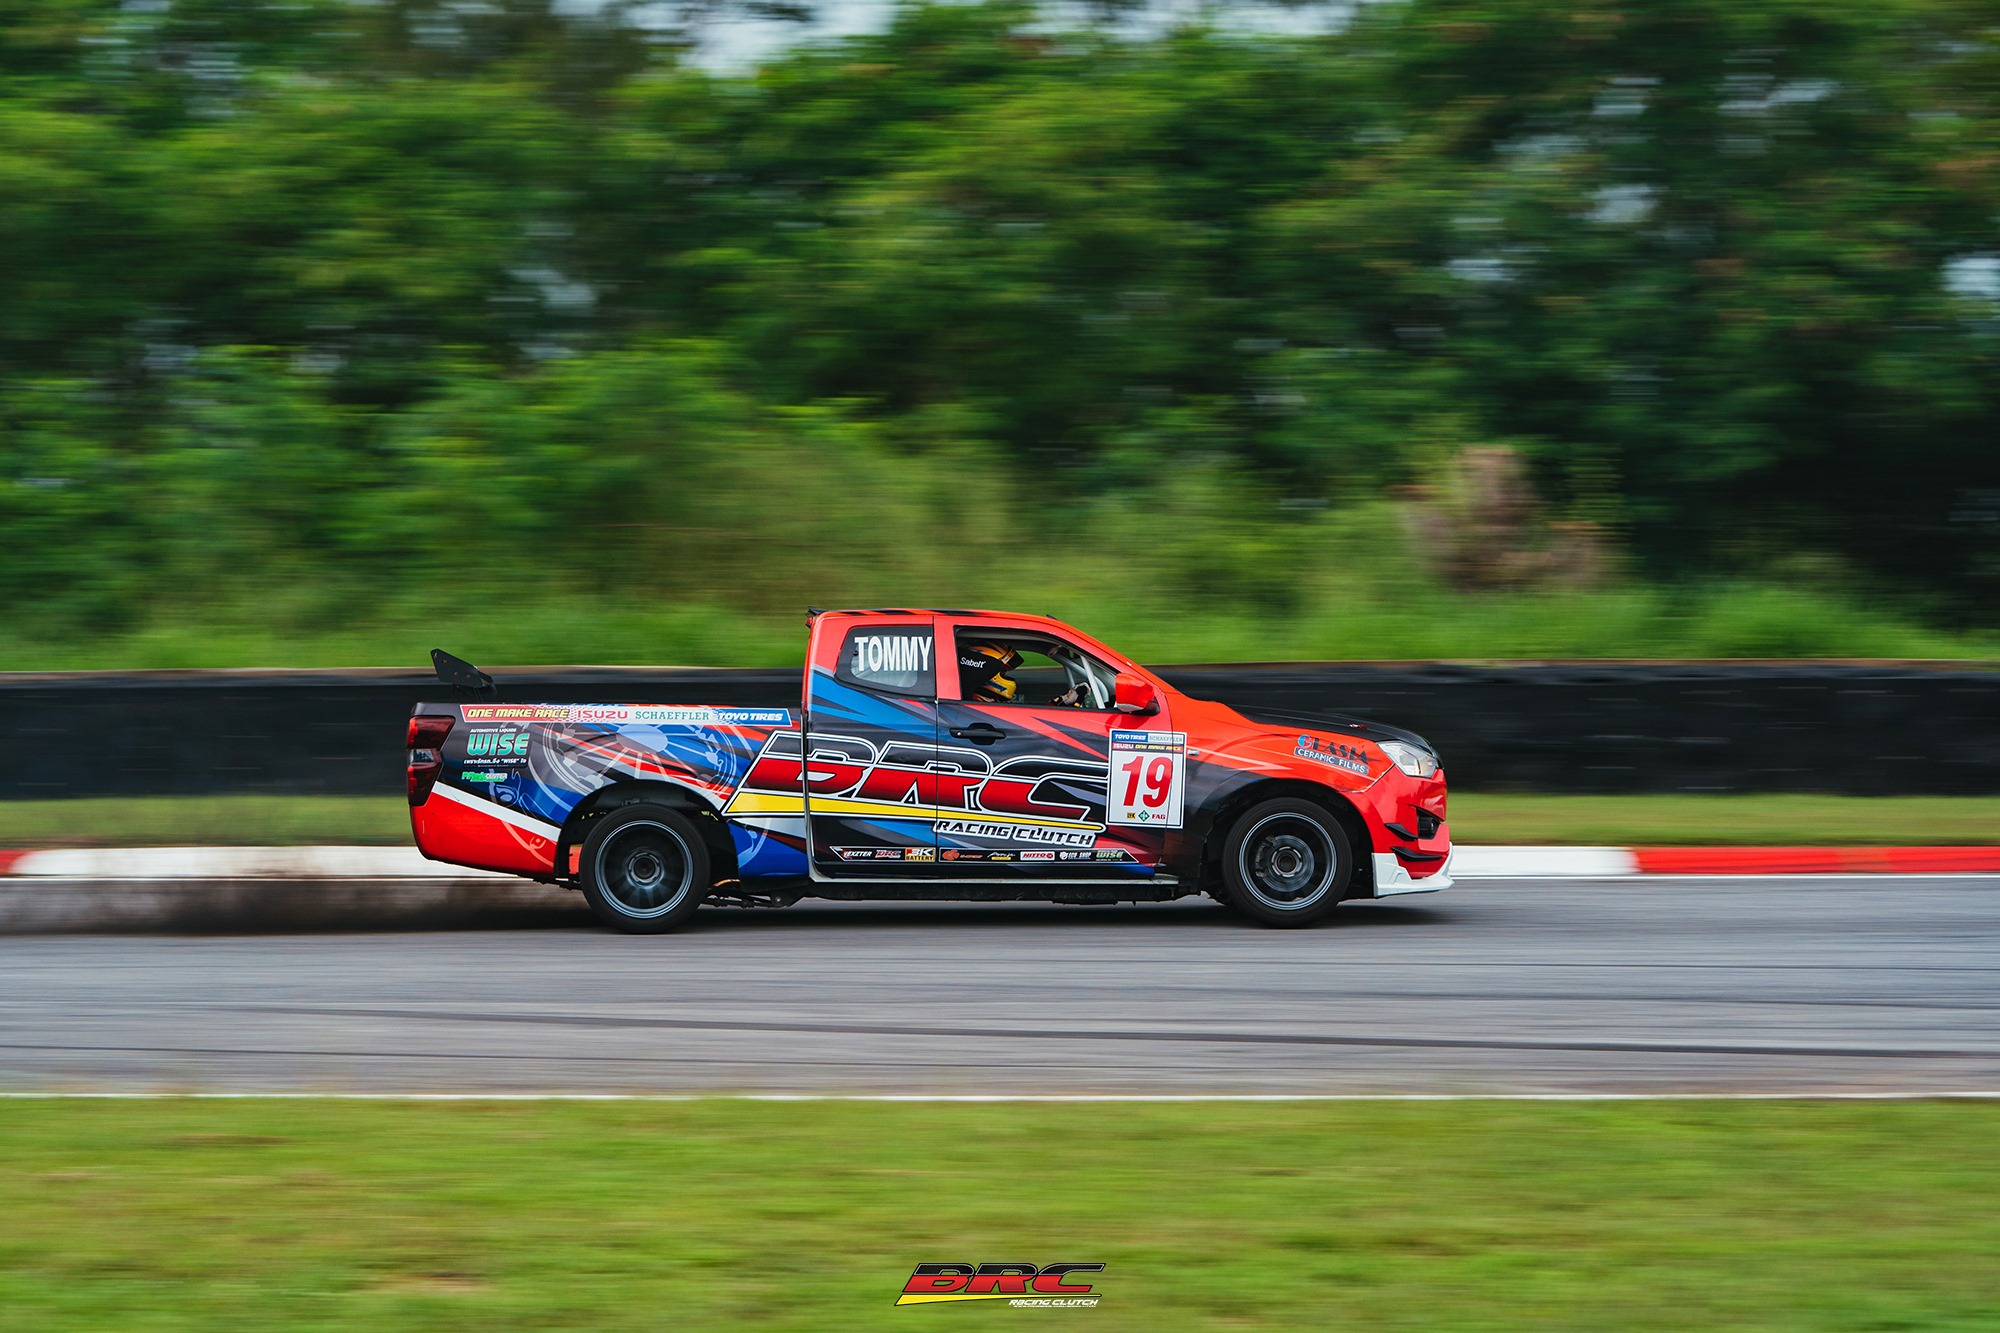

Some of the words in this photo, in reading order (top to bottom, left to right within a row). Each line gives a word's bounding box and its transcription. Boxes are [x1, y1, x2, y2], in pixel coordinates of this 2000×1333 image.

[854, 636, 932, 672] TOMMY
[960, 656, 986, 669] Sabelt
[467, 708, 496, 718] ONE
[496, 708, 532, 718] MAKE
[534, 709, 570, 718] RACE
[577, 710, 628, 719] ISUZU
[635, 711, 709, 721] SCHAEFFLER
[717, 712, 747, 721] TOYO
[749, 713, 783, 721] TIRES
[466, 733, 530, 756] WISE
[1297, 748, 1335, 764] CERAMIC
[1338, 759, 1365, 773] FILMS
[738, 730, 1108, 821] BRC
[1122, 756, 1173, 808] 19
[936, 820, 1011, 836] RACING
[1015, 828, 1093, 846] CLUTCH
[1096, 851, 1123, 859] WISE
